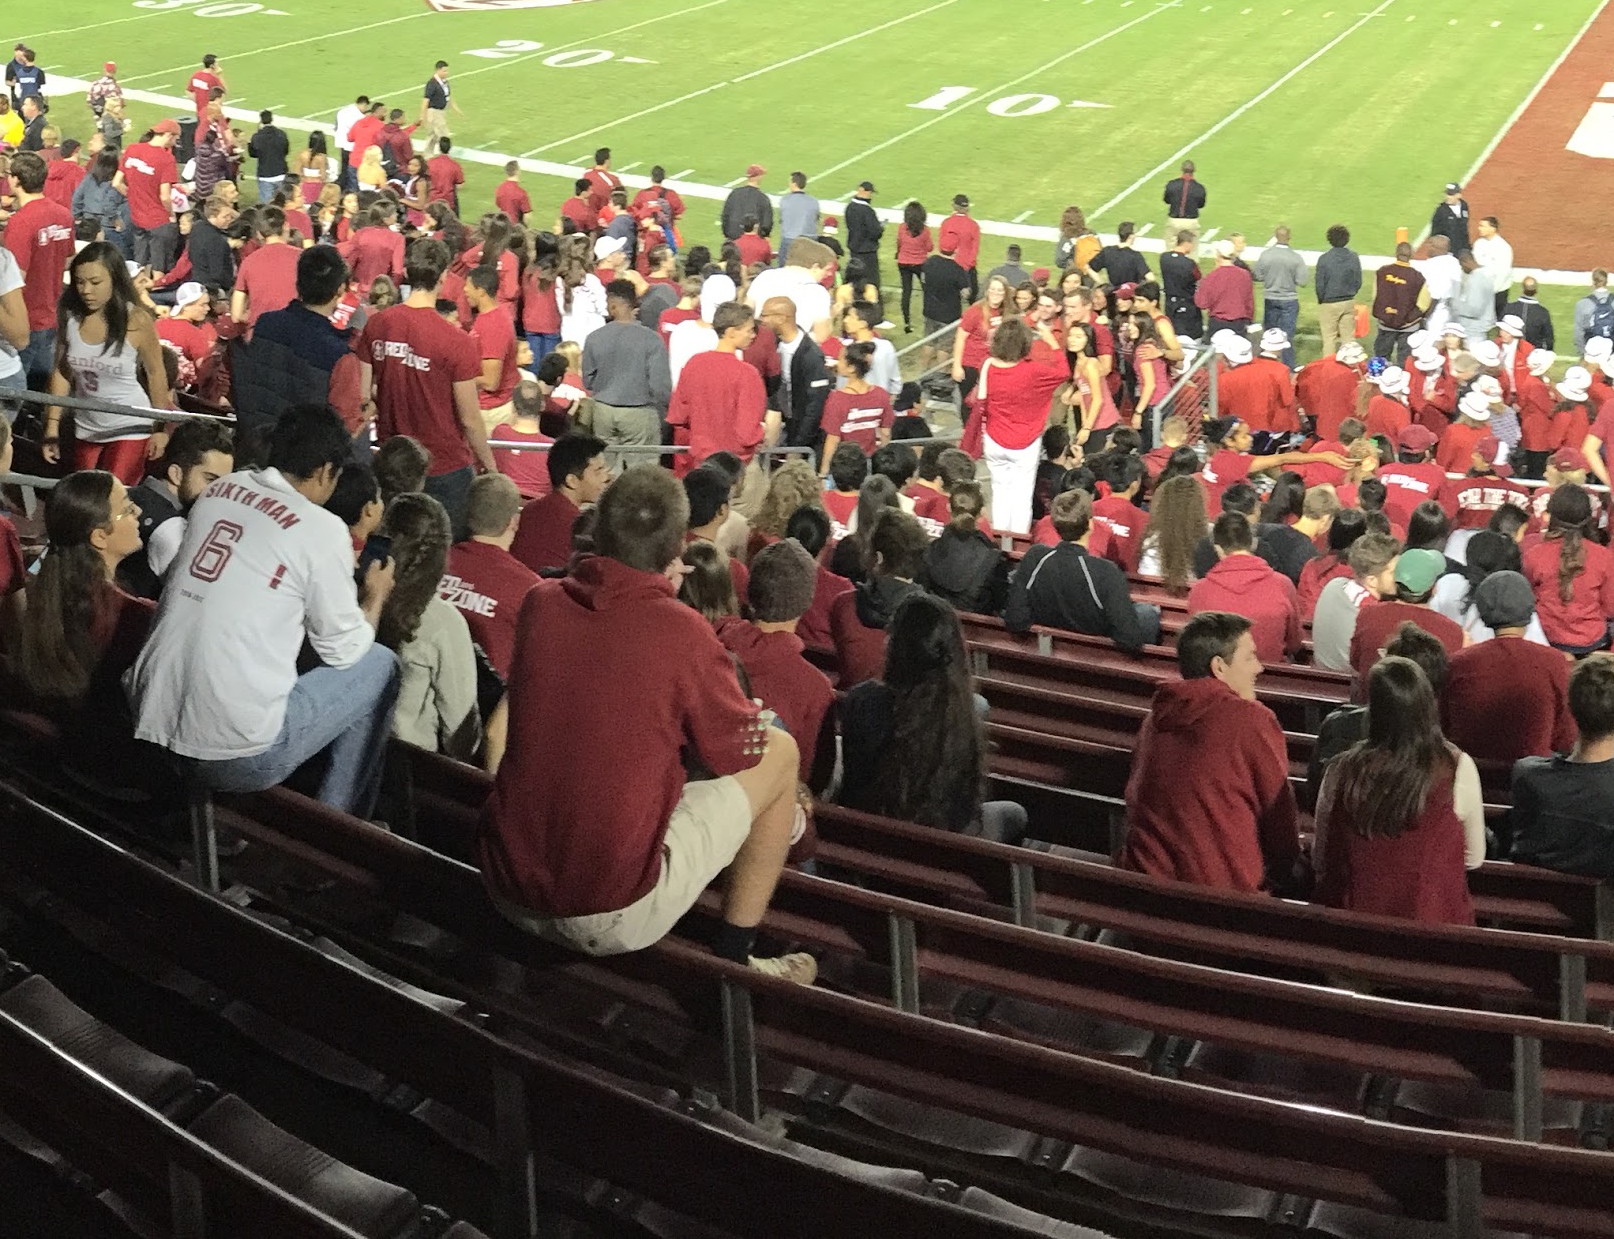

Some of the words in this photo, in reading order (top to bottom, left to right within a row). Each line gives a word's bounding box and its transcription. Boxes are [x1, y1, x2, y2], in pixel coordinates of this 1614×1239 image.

[460, 39, 615, 67] 20
[906, 86, 1062, 117] 10
[384, 341, 409, 358] RED
[69, 357, 124, 376] anford
[205, 481, 255, 508] SIXTH
[255, 496, 301, 530] MAN
[189, 518, 243, 583] 6
[447, 587, 498, 618] ZONE
